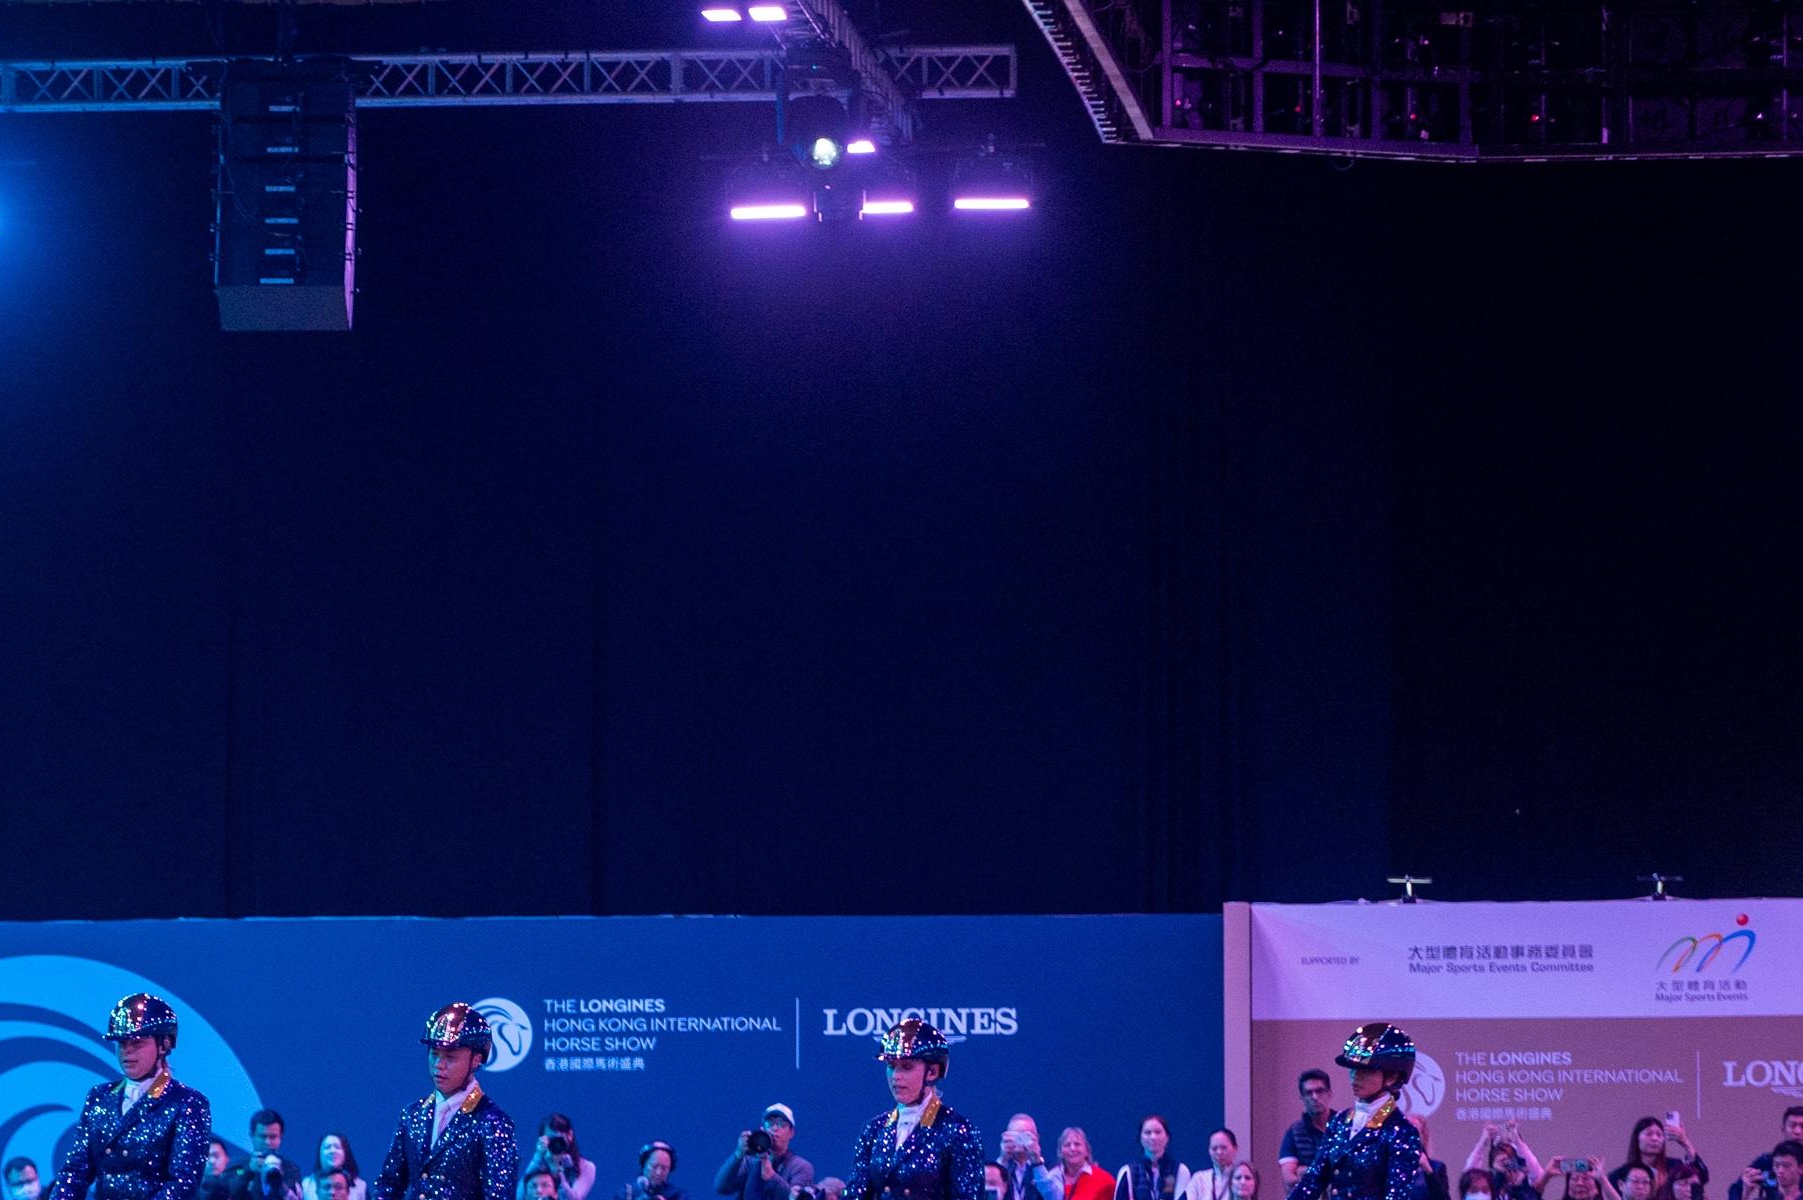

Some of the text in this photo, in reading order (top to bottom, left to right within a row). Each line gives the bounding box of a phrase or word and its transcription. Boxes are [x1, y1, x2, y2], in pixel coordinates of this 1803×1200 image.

[1409, 962, 1594, 975] Major Sports Events Committee
[1655, 992, 1749, 1003] Major Sports Events
[544, 998, 666, 1014] THE LONGINES
[544, 1016, 782, 1033] HONG KONG INTERNATIONAL
[544, 1036, 657, 1052] HORSE SHOW
[1455, 1052, 1573, 1066] THE LONGINES
[1455, 1069, 1684, 1085] HONG KONG INTERNATIONAL
[1723, 1060, 1803, 1088] LON
[1455, 1088, 1564, 1102] HORSE SHOW
